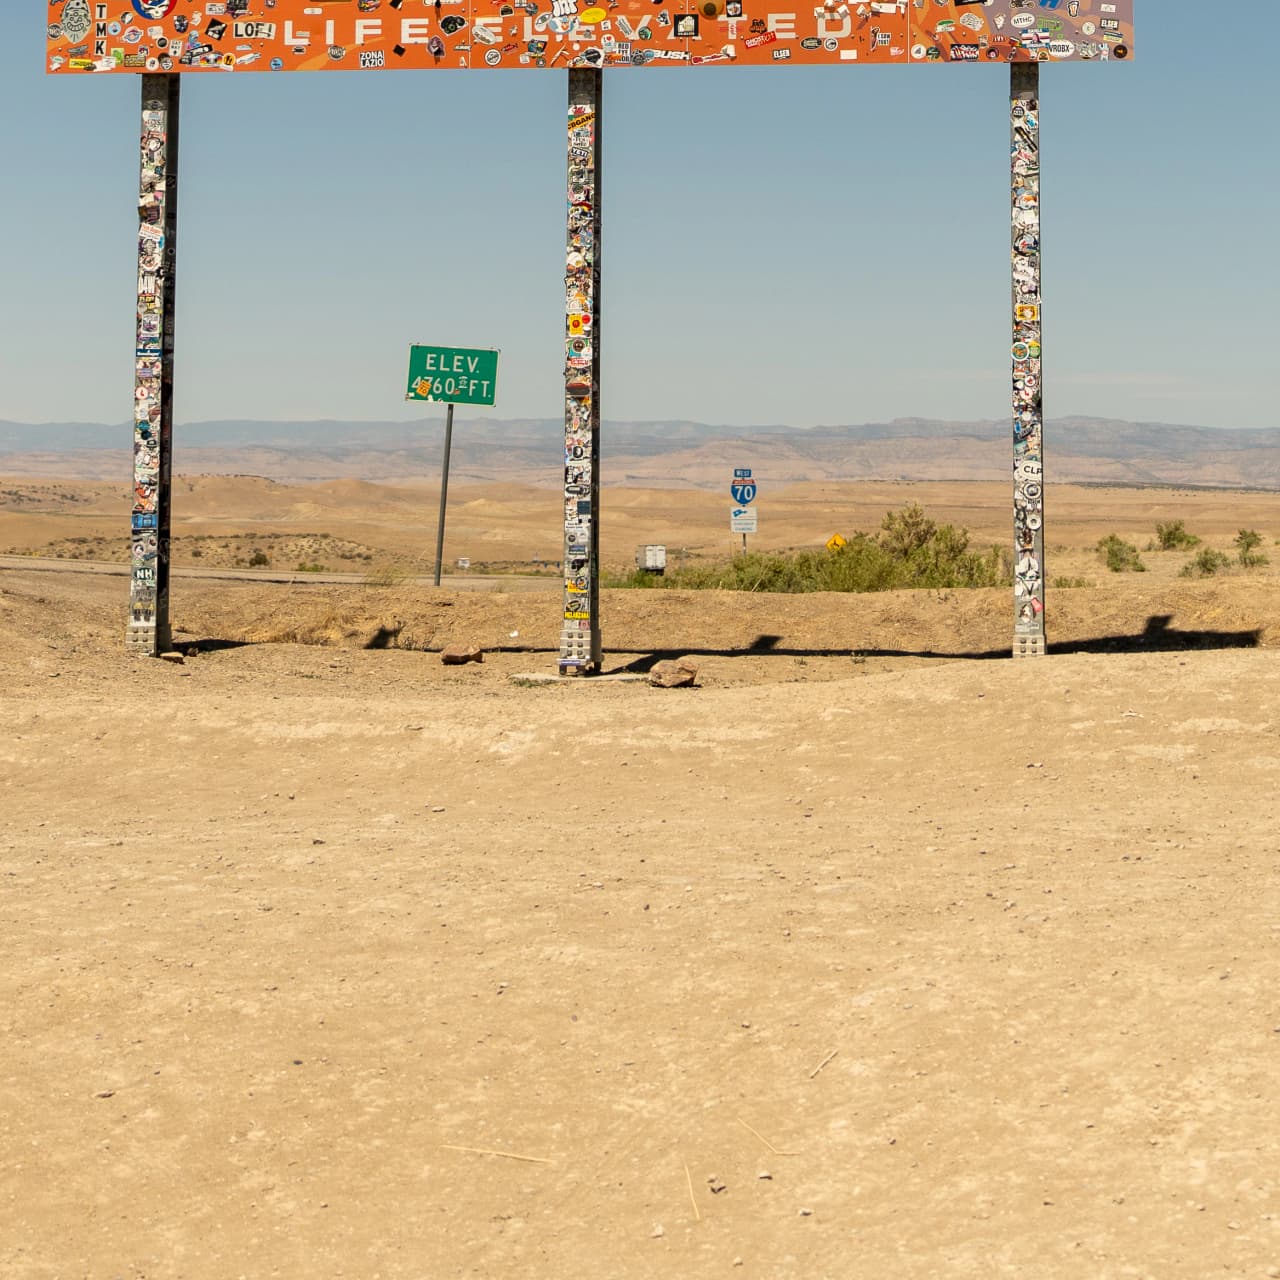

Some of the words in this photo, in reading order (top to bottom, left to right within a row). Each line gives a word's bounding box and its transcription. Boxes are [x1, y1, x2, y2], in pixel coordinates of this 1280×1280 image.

[284, 18, 429, 46] LIFE
[475, 13, 852, 43] ELEVTED
[360, 51, 383, 59] ZONA
[360, 58, 384, 68] LAZIO
[572, 147, 588, 157] YETI
[734, 485, 753, 501] 70
[135, 569, 153, 579] NH
